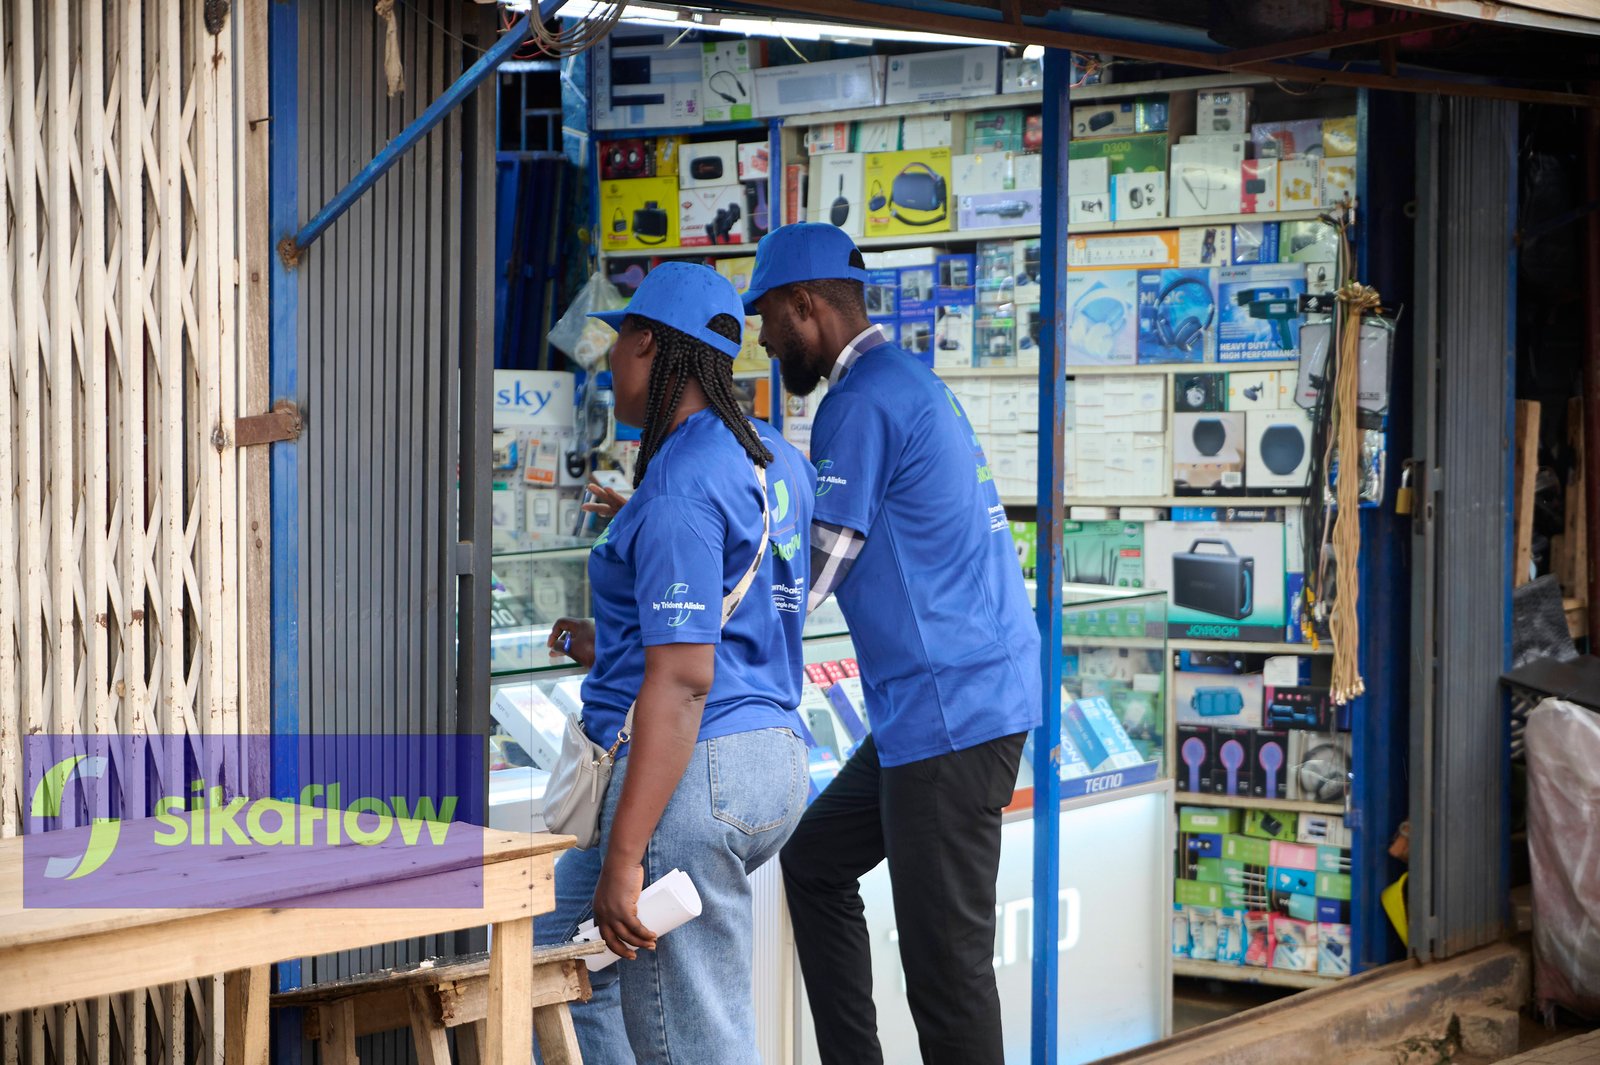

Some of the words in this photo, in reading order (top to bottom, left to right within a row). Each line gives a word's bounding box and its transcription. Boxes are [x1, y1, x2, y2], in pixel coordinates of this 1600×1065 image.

[1220, 343, 1245, 351] HEAVY
[1248, 342, 1268, 350] DUTY
[1220, 351, 1240, 360] HIGH
[652, 602, 661, 611] by
[660, 601, 683, 609] Trident
[1186, 625, 1240, 638] JOYROOM
[1097, 698, 1136, 750] CAMON
[1084, 773, 1123, 794] TECNO
